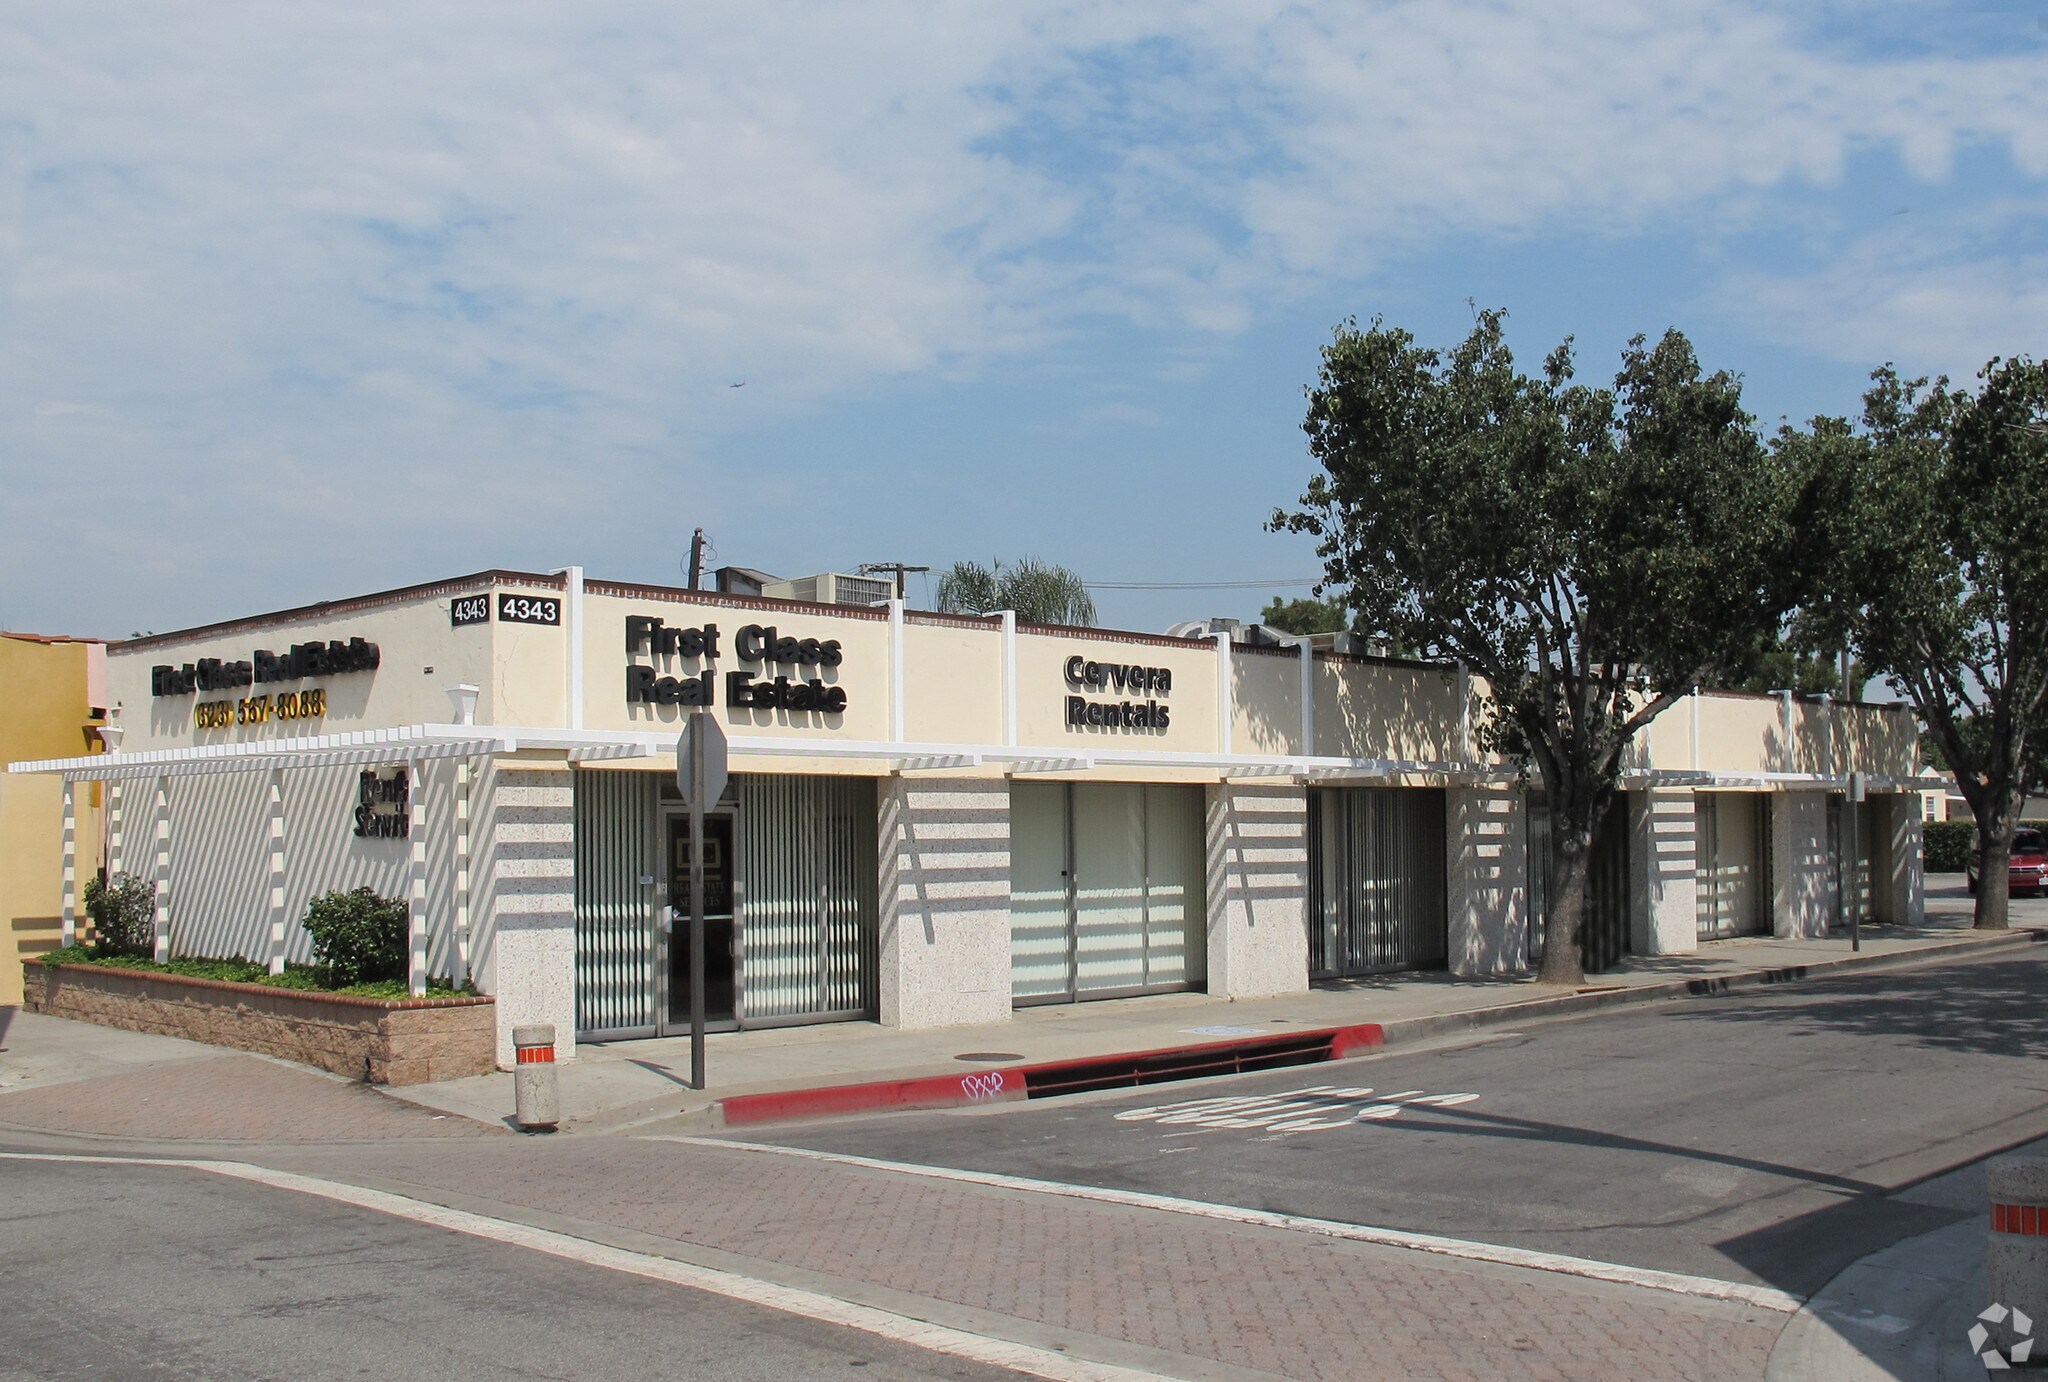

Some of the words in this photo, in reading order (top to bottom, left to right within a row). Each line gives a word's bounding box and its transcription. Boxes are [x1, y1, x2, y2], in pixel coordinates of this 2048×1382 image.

[455, 598, 487, 621] 4343
[503, 599, 556, 621] 4343
[625, 615, 721, 659] First
[735, 624, 843, 668] Class
[152, 664, 196, 697] First
[197, 658, 253, 692] Class
[254, 644, 303, 683] Real
[303, 637, 381, 677] Estate
[1063, 655, 1172, 691] Cervera
[194, 701, 235, 729] (323)
[238, 688, 327, 726] 567-8088
[626, 665, 714, 707] Real
[726, 671, 848, 714] Estate
[1064, 695, 1170, 728] Rentals
